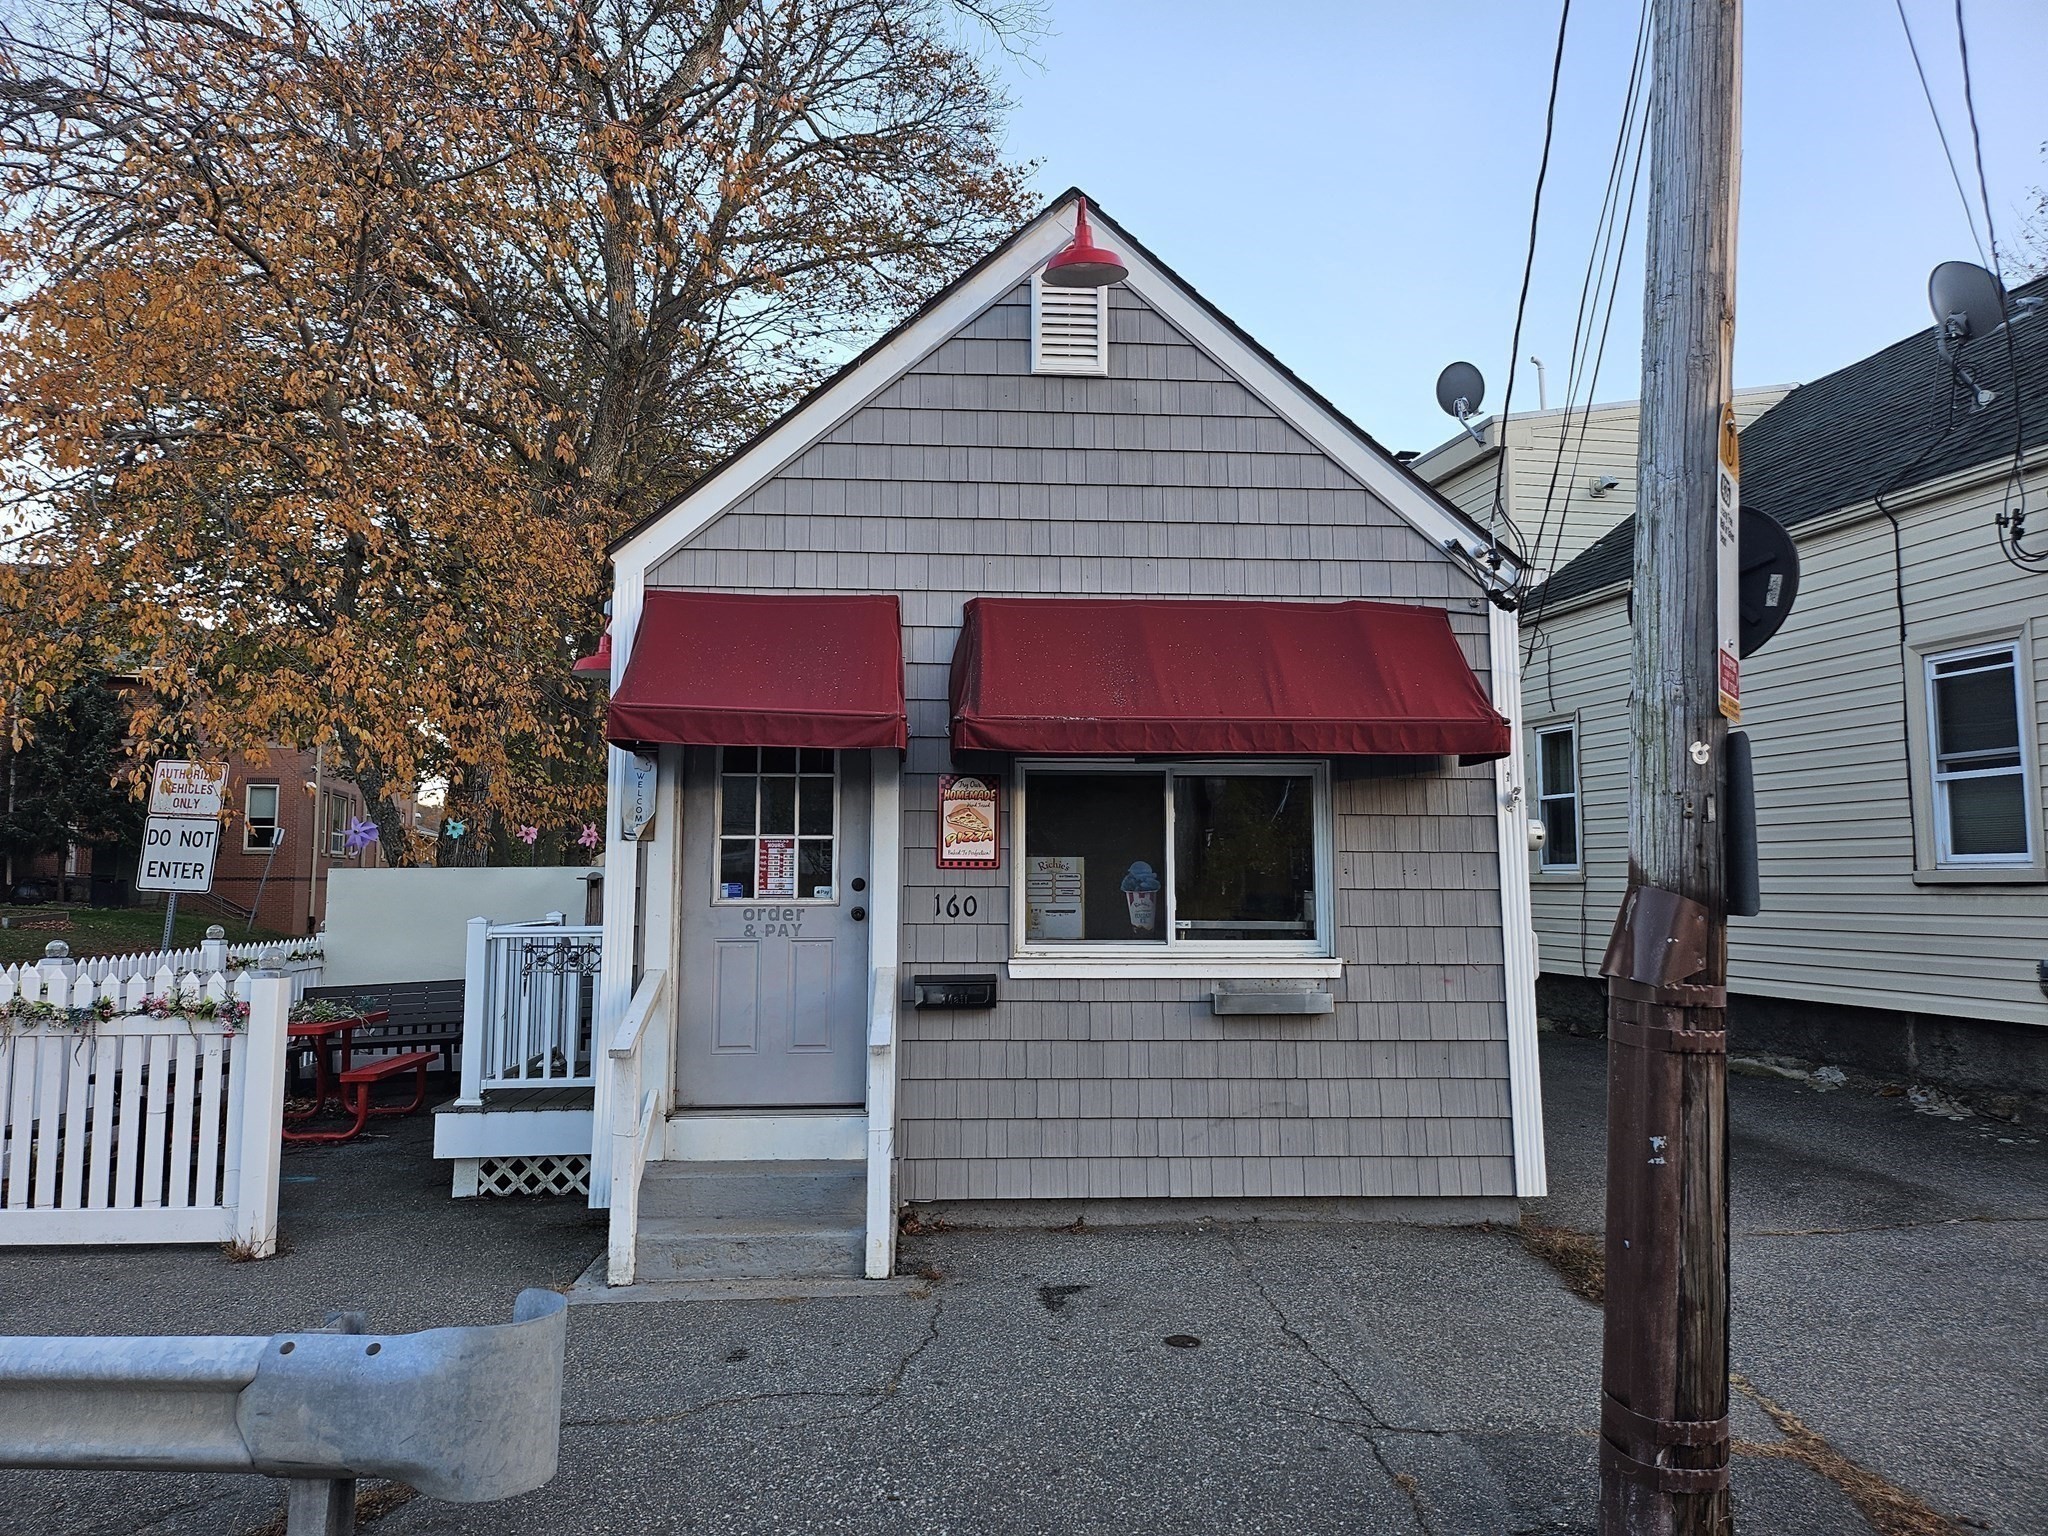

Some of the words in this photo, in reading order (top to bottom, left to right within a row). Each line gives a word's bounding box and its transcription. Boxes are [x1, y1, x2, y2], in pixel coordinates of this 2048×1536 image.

[166, 783, 214, 795] EHICLES
[958, 780, 969, 790] Try
[944, 789, 996, 801] HOMEMADE
[172, 797, 201, 809] ONLY
[147, 829, 171, 846] DO
[179, 830, 215, 848] NOT
[945, 829, 993, 847] PIZZA
[146, 861, 205, 879] ENTER
[1037, 858, 1070, 872] Richie's
[935, 893, 977, 918] 160
[743, 906, 805, 921] order
[743, 923, 756, 937] &
[765, 923, 803, 937] PAY
